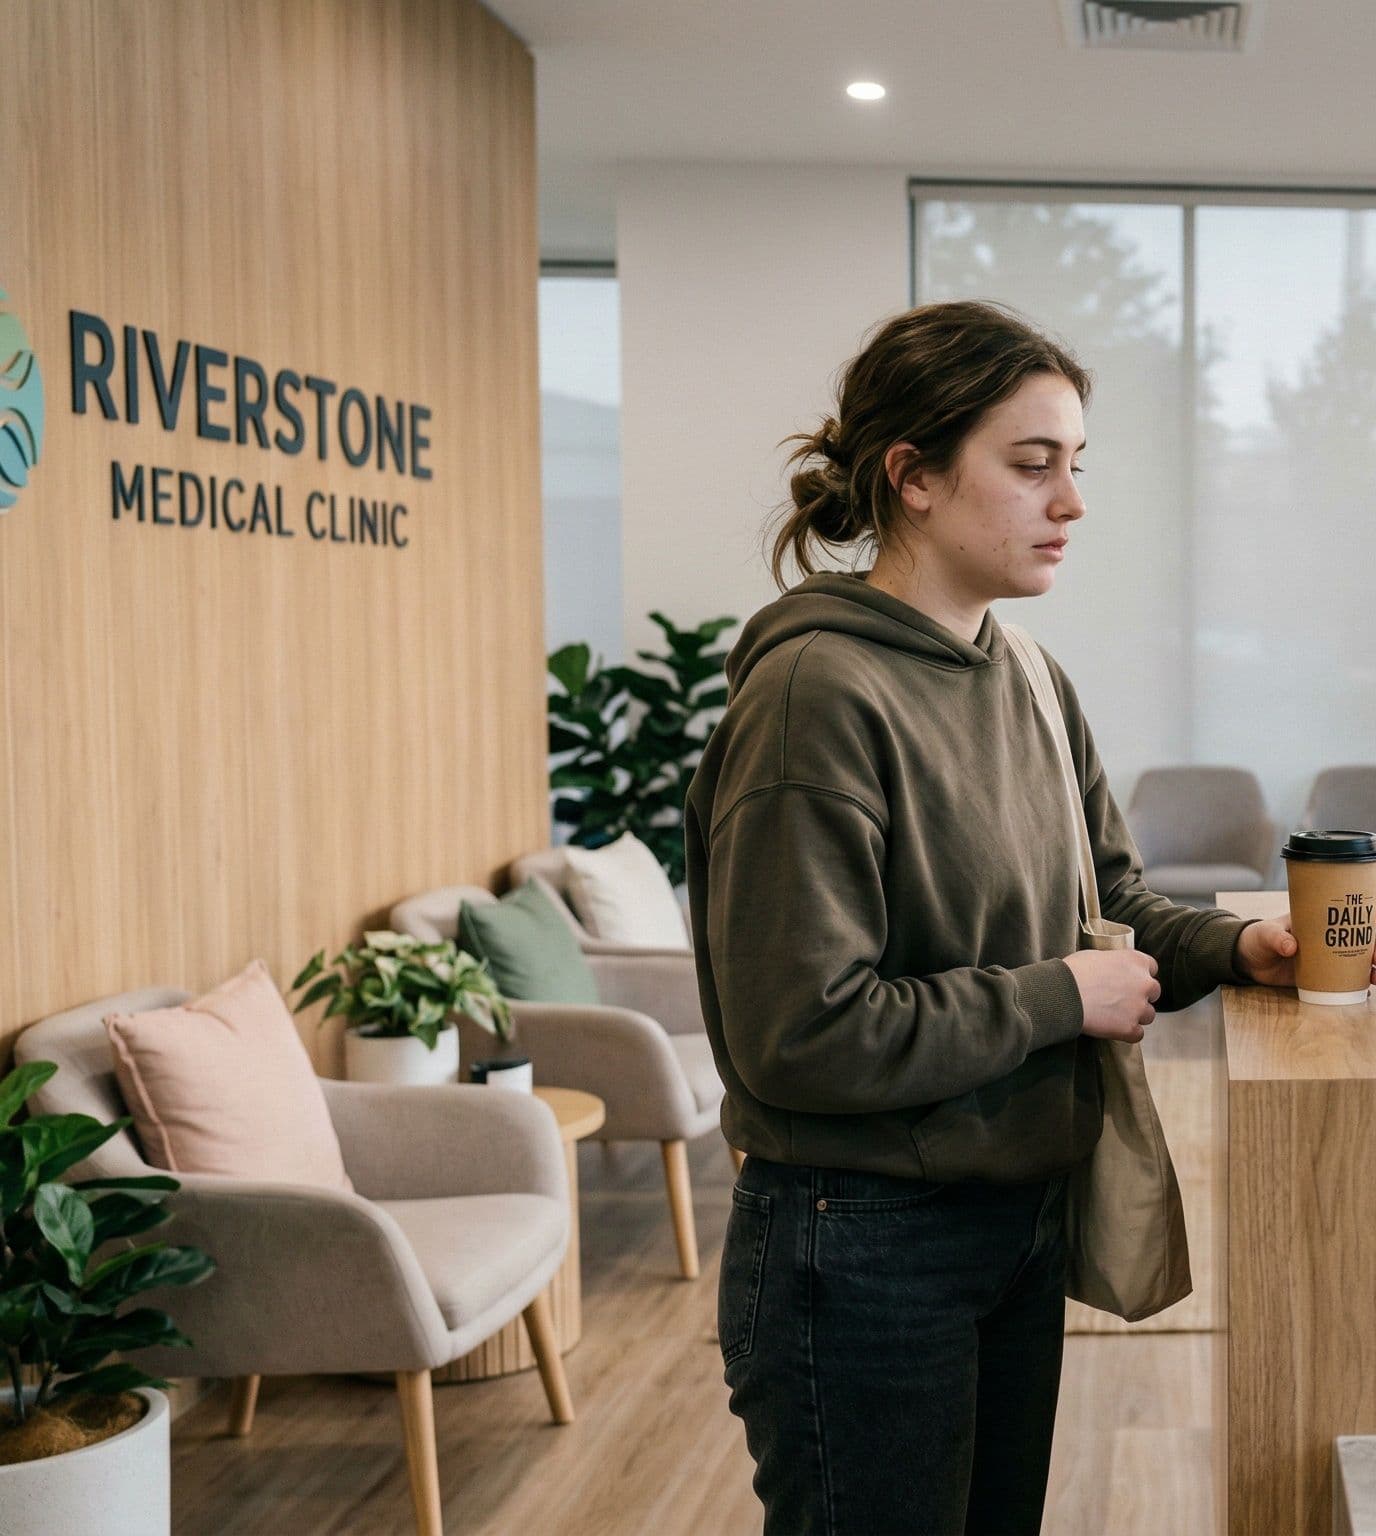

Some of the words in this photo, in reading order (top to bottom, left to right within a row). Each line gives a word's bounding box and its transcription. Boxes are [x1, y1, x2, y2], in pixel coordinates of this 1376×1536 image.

[69, 309, 434, 480] RIVERSTONE
[111, 460, 294, 536] MEDICAL
[306, 490, 410, 548] CLINIC
[1345, 894, 1363, 905] THE
[1328, 905, 1373, 926] DAILY
[1325, 926, 1373, 947] GRIND
